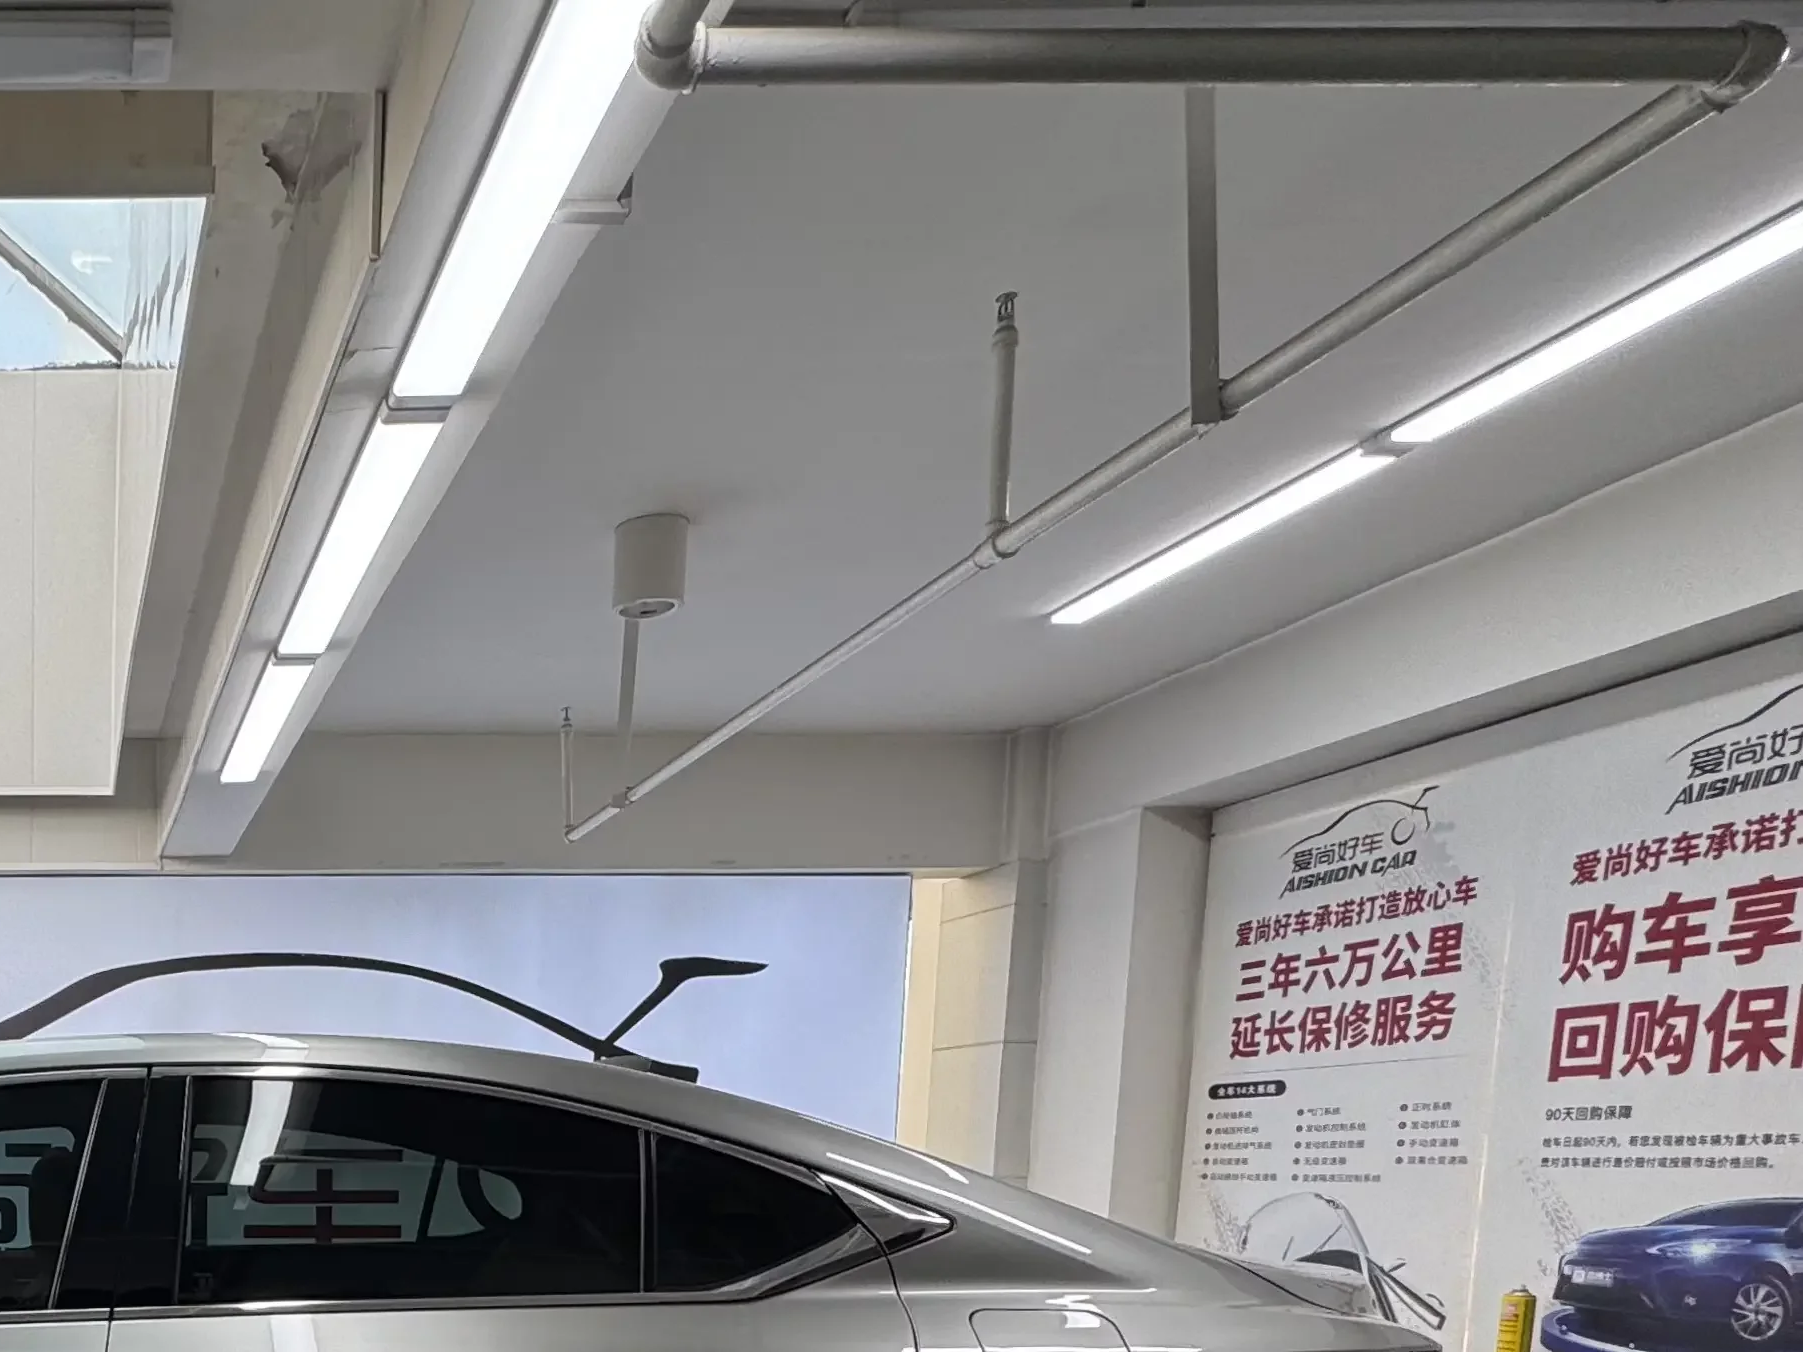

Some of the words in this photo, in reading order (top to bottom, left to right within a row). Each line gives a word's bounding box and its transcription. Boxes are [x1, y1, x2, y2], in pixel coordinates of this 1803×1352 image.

[1687, 722, 1803, 780] 爱尚好
[1279, 861, 1368, 899] AISHION
[1370, 850, 1418, 877] CAR
[1291, 832, 1385, 873] 爱尚好车
[1569, 808, 1803, 886] 爱尚好车承诺打
[1235, 875, 1479, 947] 爱尚好车承诺打造放心车
[1558, 874, 1803, 985] 购车享
[1235, 922, 1464, 1002] 三年六万公里
[1229, 990, 1457, 1060] 延长保修服务
[1547, 983, 1803, 1082] 回购保
[1545, 1105, 1633, 1121] 90天回购保障
